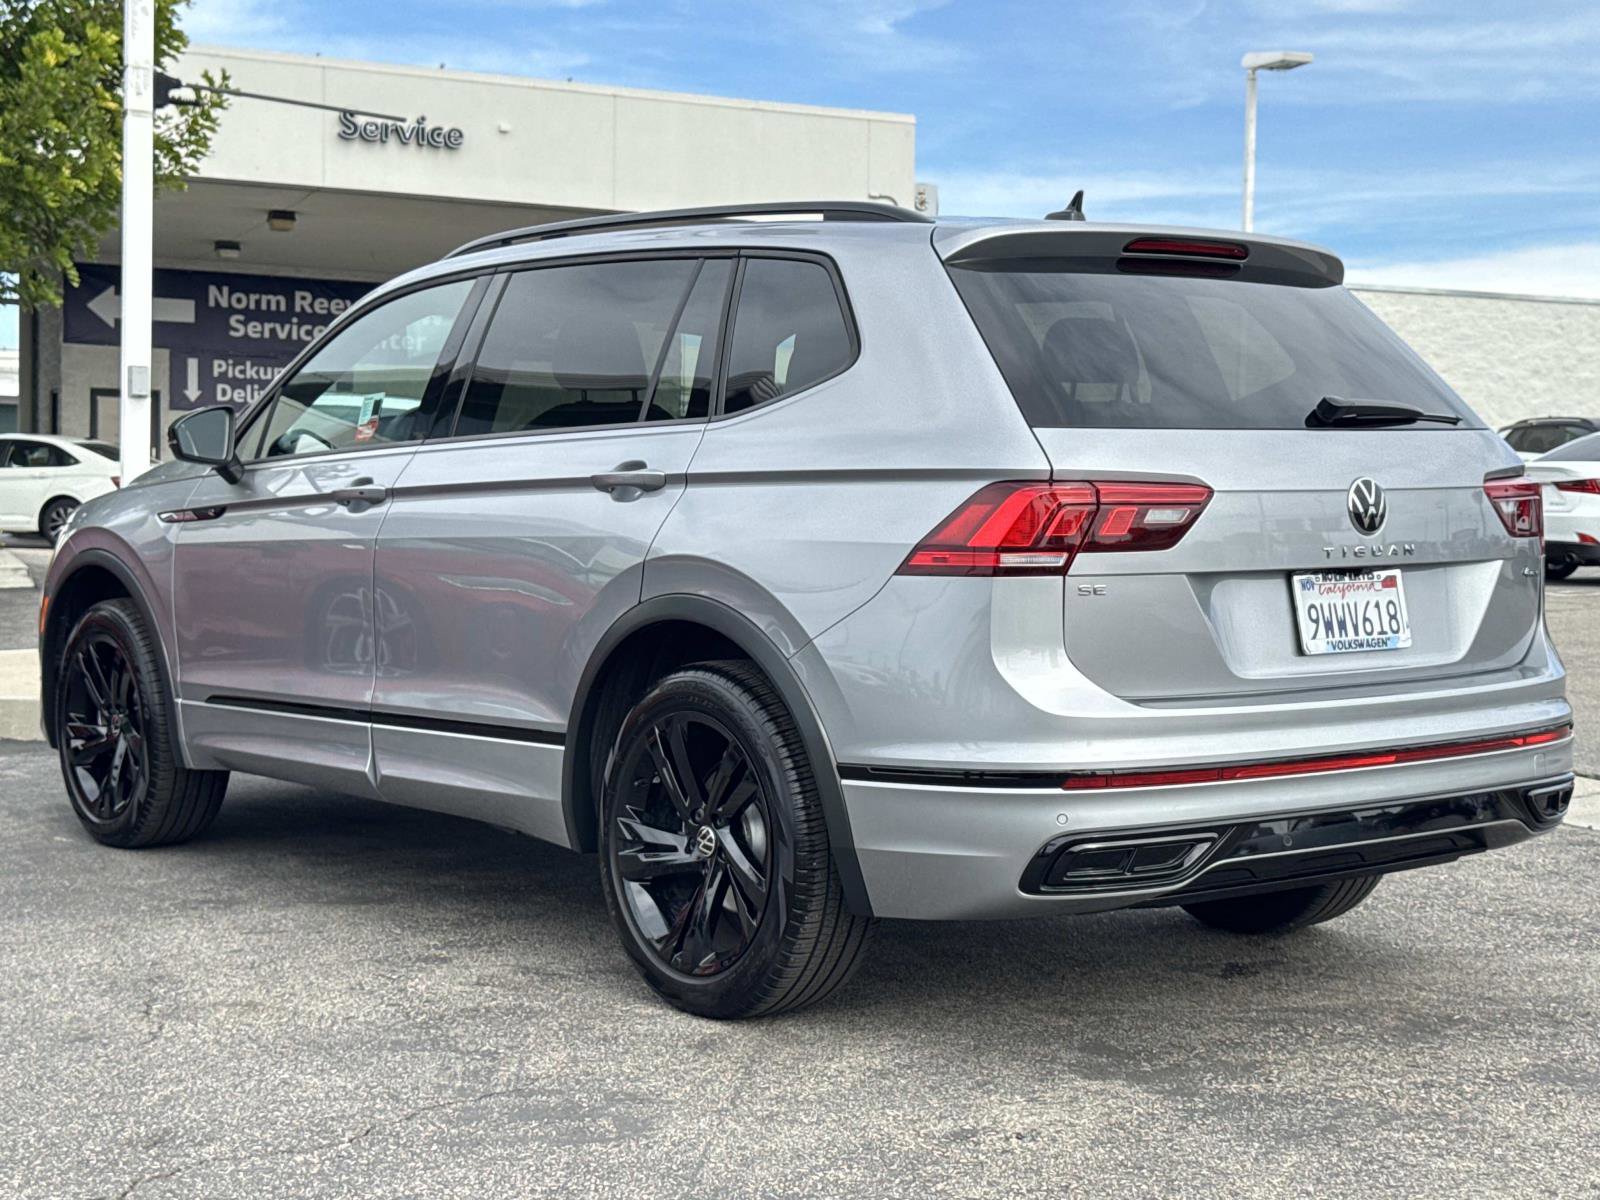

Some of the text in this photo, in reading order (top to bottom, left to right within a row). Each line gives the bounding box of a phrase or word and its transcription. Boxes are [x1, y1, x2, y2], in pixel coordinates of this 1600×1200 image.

[338, 111, 464, 149] Service
[207, 284, 286, 312] Norm
[228, 314, 326, 342] Service
[1323, 543, 1416, 560] TIGUAN
[1077, 584, 1107, 597] SE
[1319, 582, 1383, 600] California
[1307, 600, 1401, 641] 9WWV618
